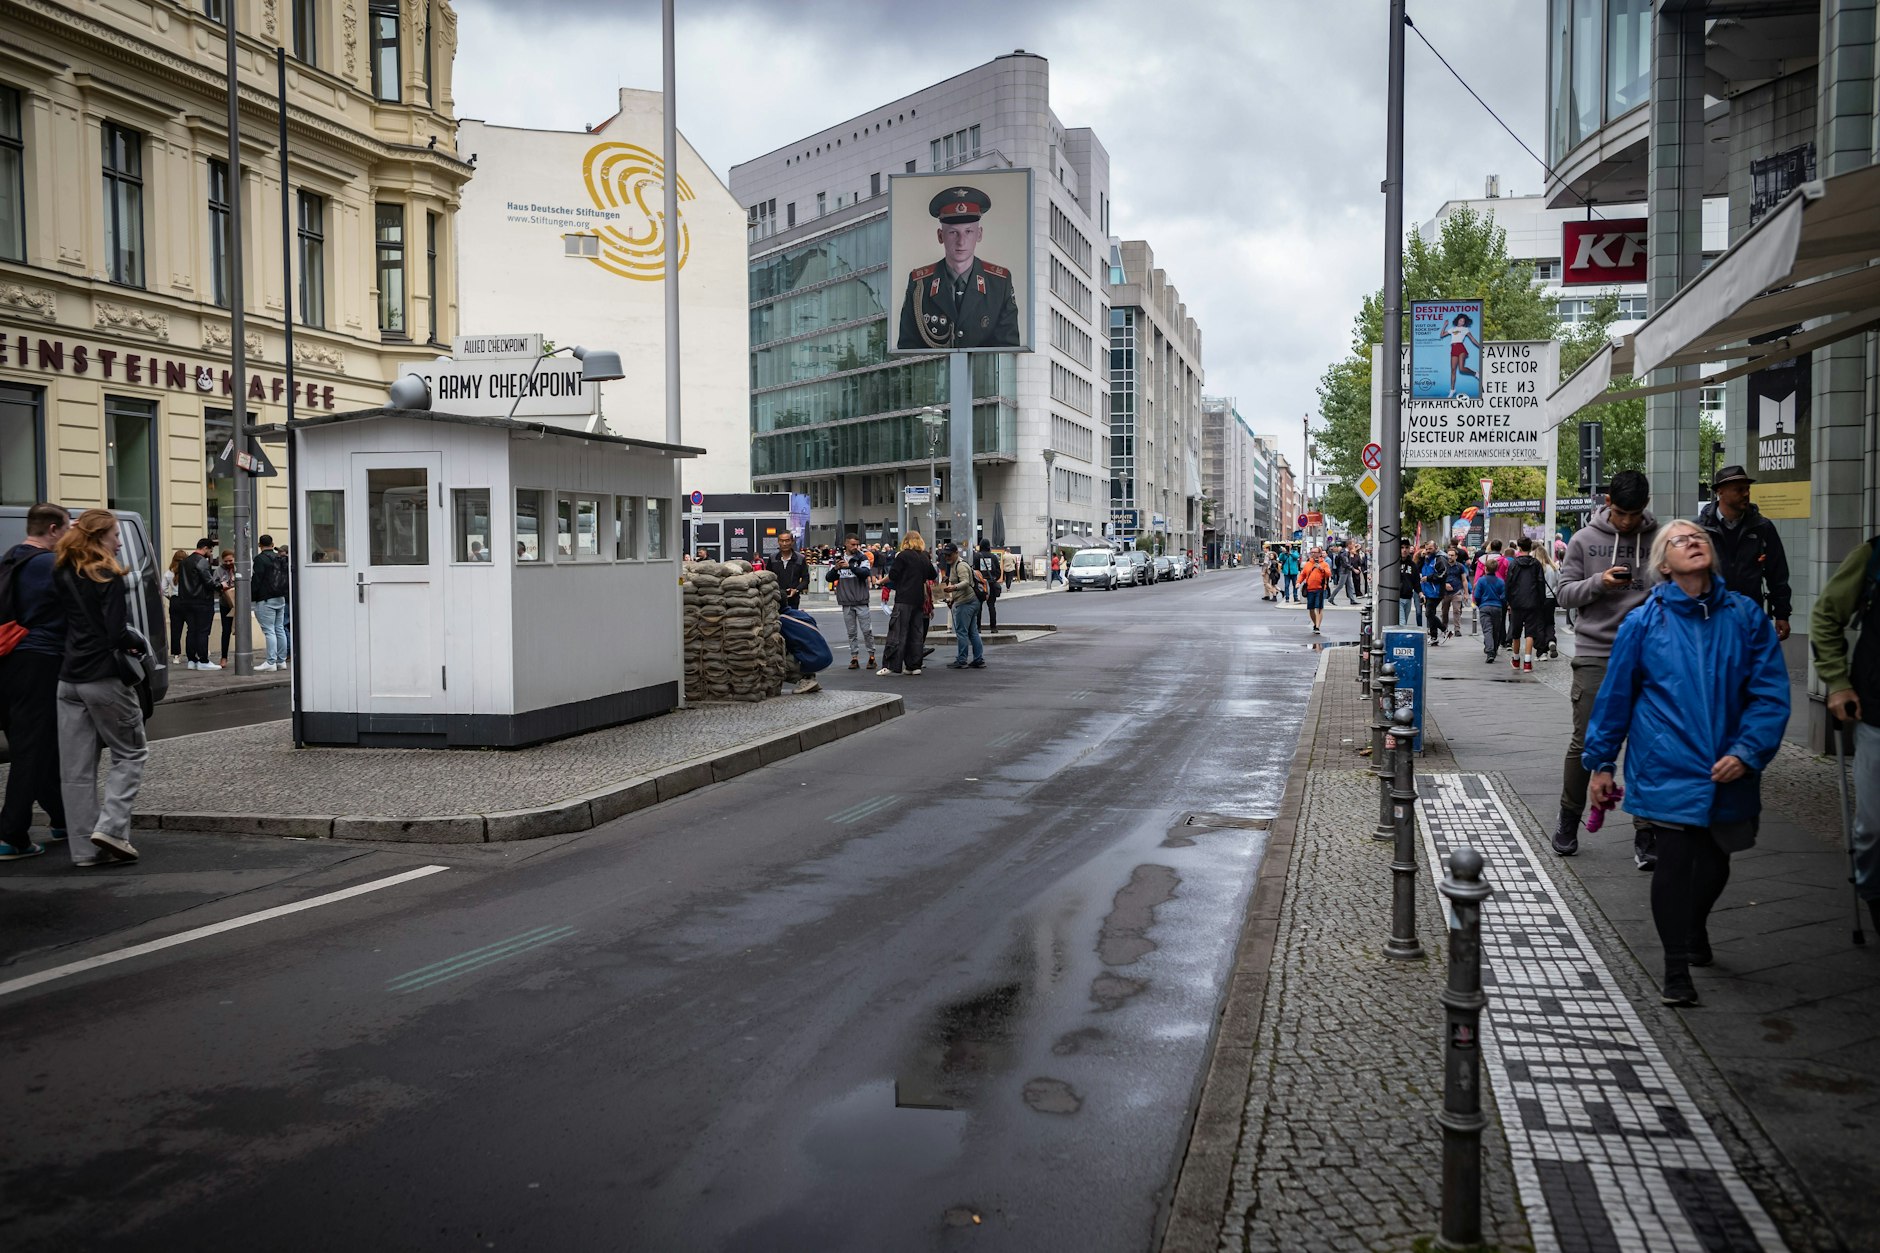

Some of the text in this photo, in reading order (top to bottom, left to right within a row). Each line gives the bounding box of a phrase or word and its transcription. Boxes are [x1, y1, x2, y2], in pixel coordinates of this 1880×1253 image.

[507, 202, 621, 220] Haus Deutscher Stiftungen
[507, 214, 590, 230] www.Stiftungen.org
[1569, 231, 1648, 270] KF
[1415, 305, 1479, 313] DESTINATION
[1415, 313, 1443, 321] STYLE
[464, 337, 529, 354] ALLIED CHECKPOINT
[1482, 346, 1530, 358] AVING
[1491, 361, 1538, 374] SECTOR
[439, 374, 483, 399] ARMY
[489, 371, 583, 399] CHECKPOINT
[1517, 381, 1535, 393] ИЗ
[1490, 396, 1539, 408] СЕКТОРА
[1411, 415, 1510, 427] VOUS SORTEZ
[1411, 431, 1465, 443] SECTEUR
[1469, 428, 1537, 443] AMÉRICAIN
[1401, 449, 1537, 458] VERLASSEN DEN AMERIKANISCHEN SEKTOR
[1759, 438, 1796, 458] MAUER
[1758, 455, 1796, 472] MUSEUM
[1588, 544, 1651, 560] SUPERD
[1395, 648, 1413, 656] DDR
